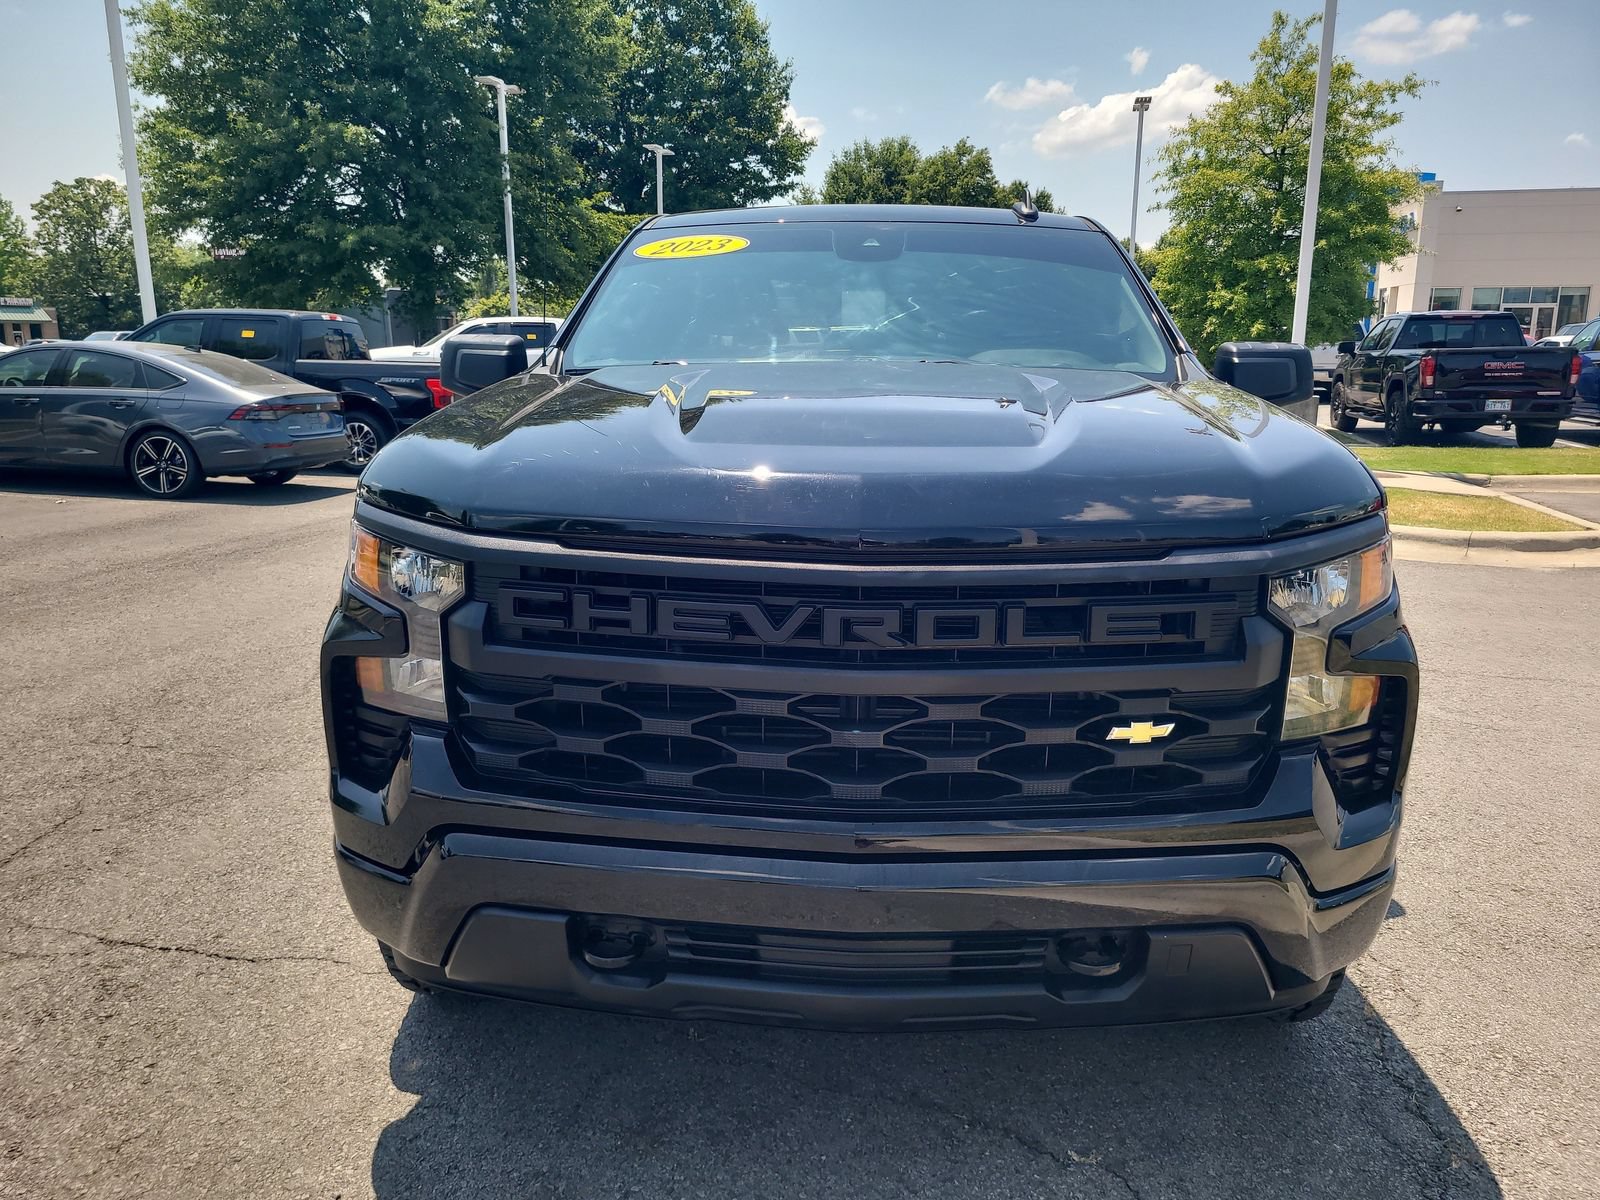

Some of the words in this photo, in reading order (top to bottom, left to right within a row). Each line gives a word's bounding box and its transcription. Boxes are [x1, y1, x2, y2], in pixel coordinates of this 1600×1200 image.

[650, 238, 733, 256] 2023
[1484, 361, 1525, 370] GMC
[496, 584, 1240, 649] CHEVROLET
